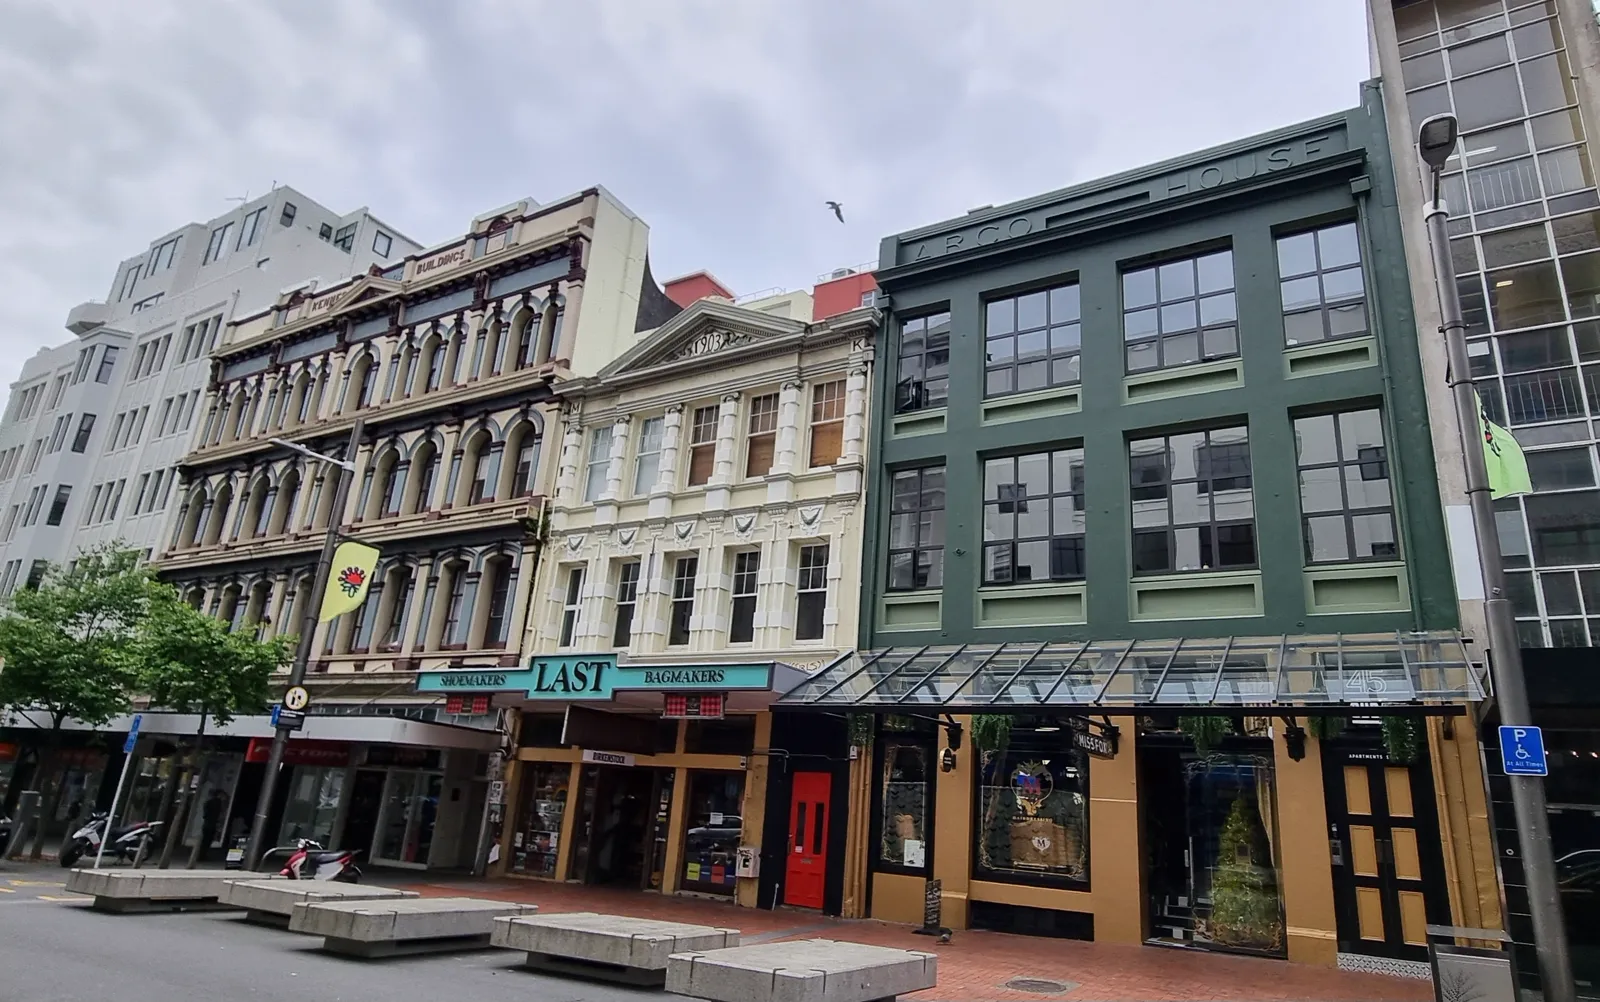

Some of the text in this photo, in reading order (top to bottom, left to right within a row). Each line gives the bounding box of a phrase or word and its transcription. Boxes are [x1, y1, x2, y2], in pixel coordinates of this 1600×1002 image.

[915, 135, 1330, 262] ARCO HOUSE
[693, 333, 723, 356] 1903
[851, 339, 863, 351] K
[570, 402, 580, 414] M
[440, 661, 725, 693] SHOEMAKERS LAST BAGMAKERS
[1346, 669, 1387, 694] 45
[1078, 734, 1095, 751] MISS
[1513, 728, 1527, 743] P
[254, 745, 348, 759] FCTORY
